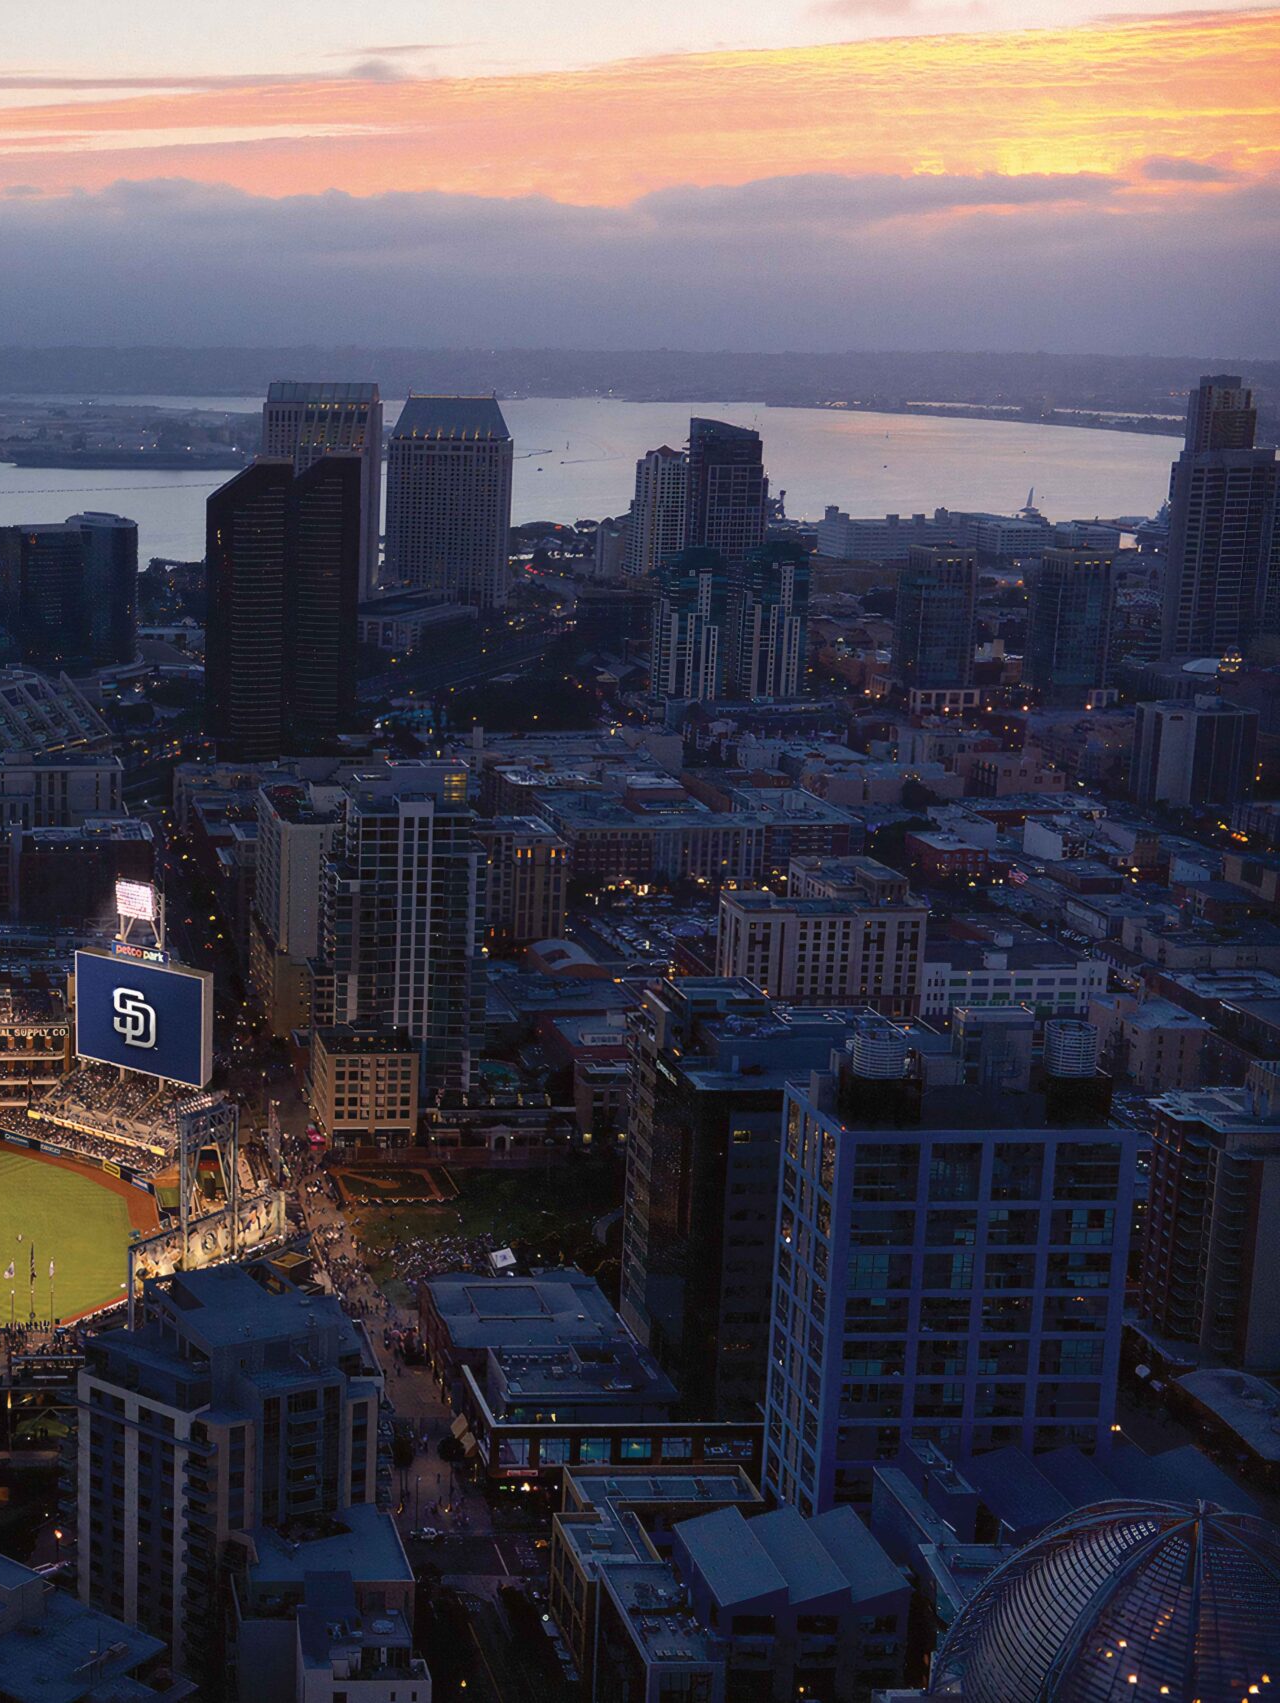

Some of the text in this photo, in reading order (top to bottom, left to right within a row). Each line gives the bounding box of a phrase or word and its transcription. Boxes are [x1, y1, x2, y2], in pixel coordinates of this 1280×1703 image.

[116, 945, 163, 962] petco park
[113, 987, 156, 1048] SD
[15, 1028, 49, 1036] SUPPLY
